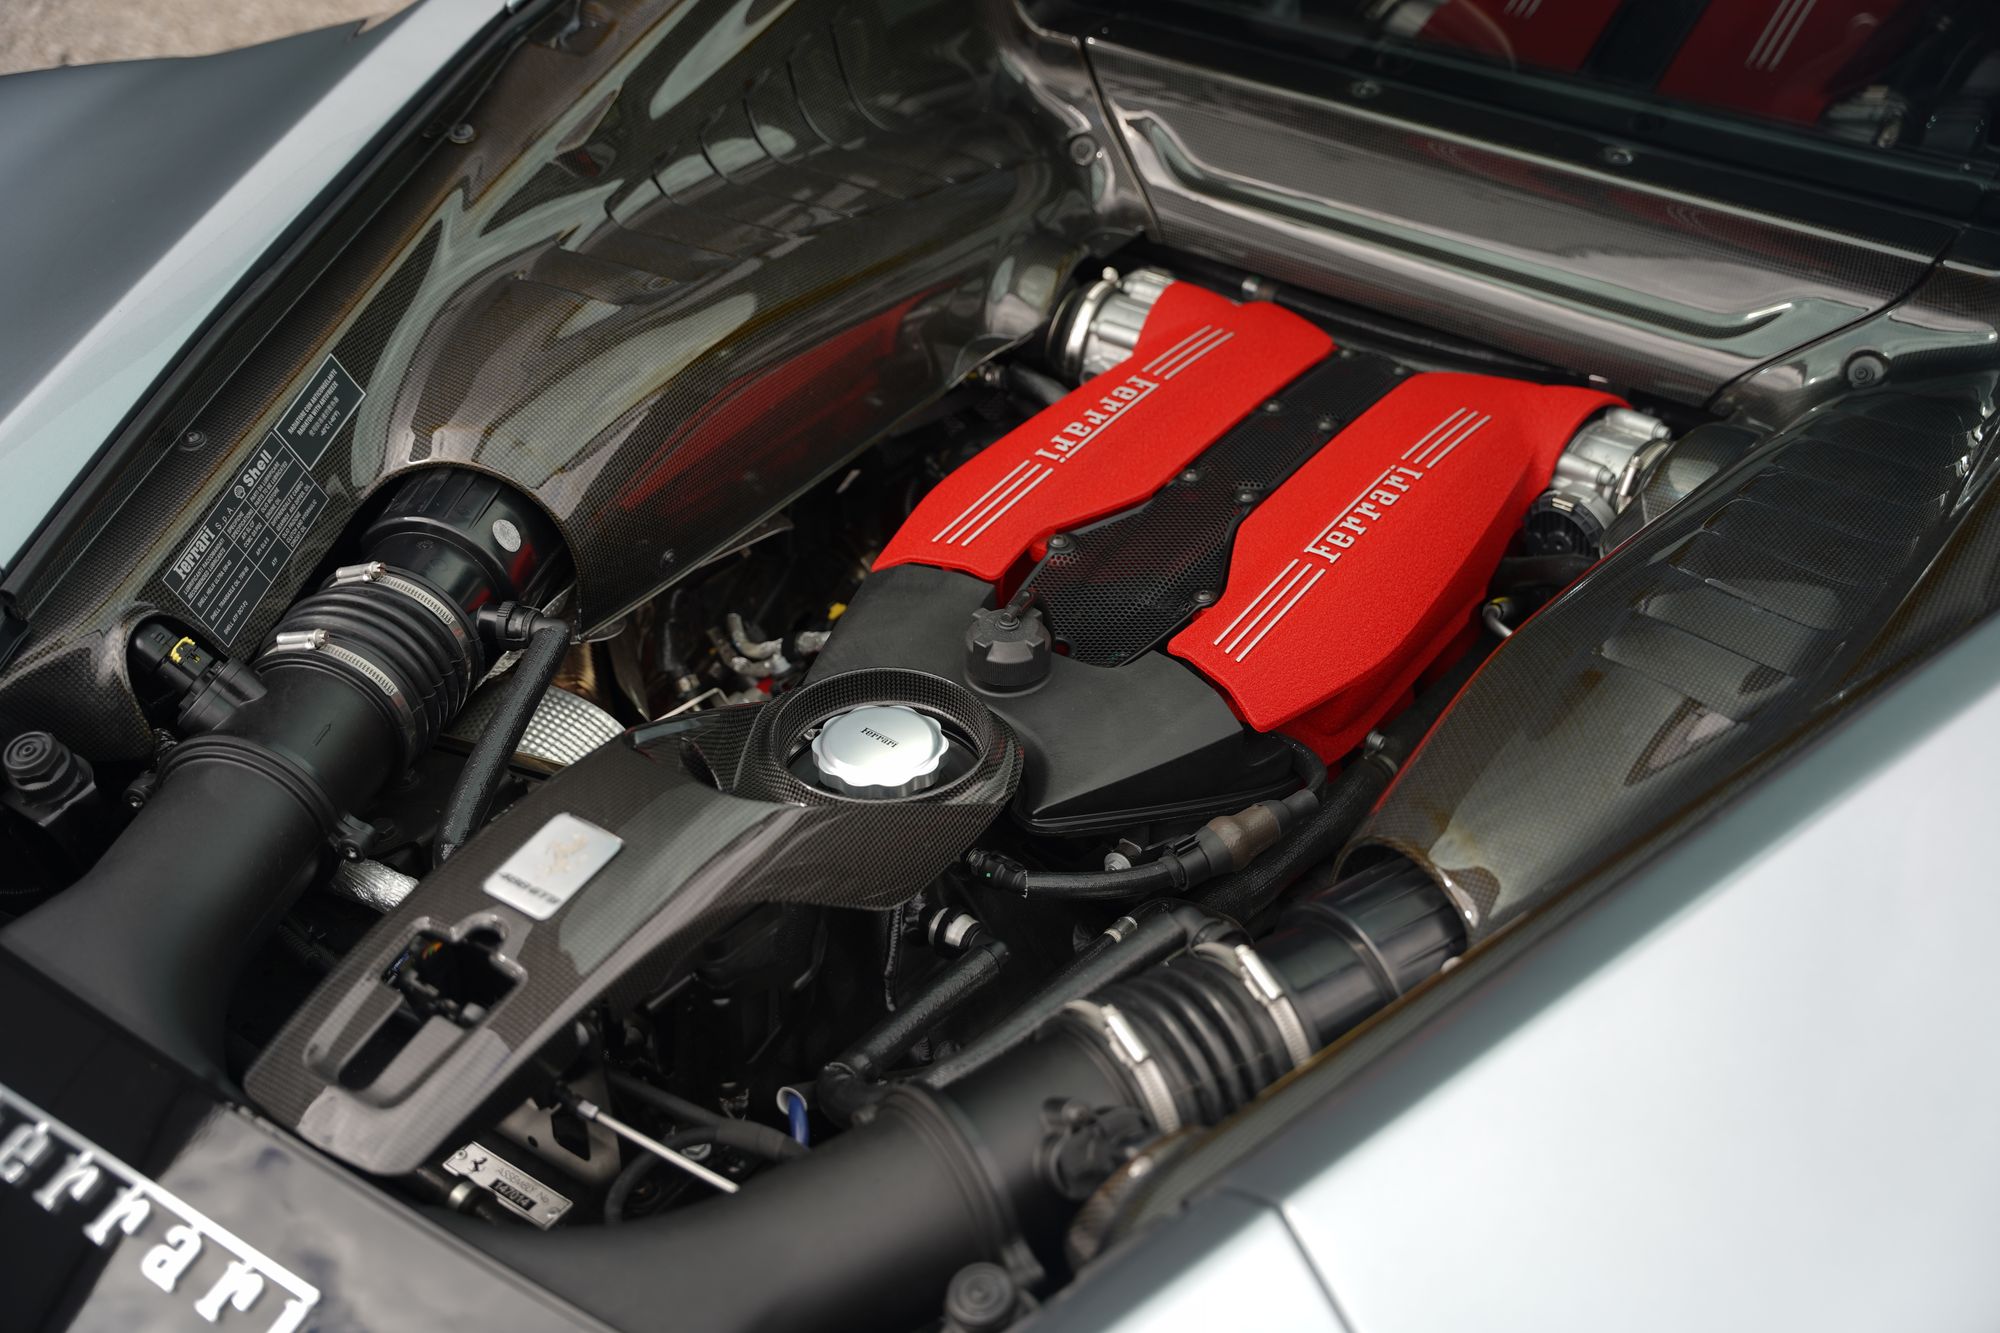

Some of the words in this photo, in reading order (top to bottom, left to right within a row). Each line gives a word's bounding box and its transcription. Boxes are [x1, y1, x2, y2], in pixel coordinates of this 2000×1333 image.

[287, 409, 308, 435] RADIATORE
[303, 401, 313, 413] CON
[310, 368, 338, 405] ANTICONGELANTE
[296, 413, 315, 436] RADIATOR
[310, 403, 322, 417] WITH
[318, 380, 339, 407] ANTIFREEZE
[1035, 375, 1159, 463] Ferrari
[270, 460, 288, 485] LUBRICATED
[260, 502, 270, 514] OLIO
[266, 486, 280, 505] MOTORE
[264, 503, 277, 519] ENGINE
[172, 525, 216, 581] Ferrari
[242, 449, 273, 488] Shell
[230, 508, 254, 540] SPECIFICATIONS
[275, 512, 290, 532] GEARBOX
[1304, 464, 1424, 564] Ferrari
[281, 527, 290, 539] OLIO
[285, 526, 298, 544] CLUTCH
[289, 530, 302, 548] CIRCUIT
[187, 569, 210, 601] RECOMMENDED
[207, 547, 226, 573] LUBRICANTS
[197, 594, 209, 608] SHELL
[209, 607, 221, 622] SHELL
[223, 621, 235, 635] SHELL
[861, 727, 898, 748] Ferrari
[496, 1167, 537, 1193] ASSEMBLY
[0, 1082, 321, 1333] errari
